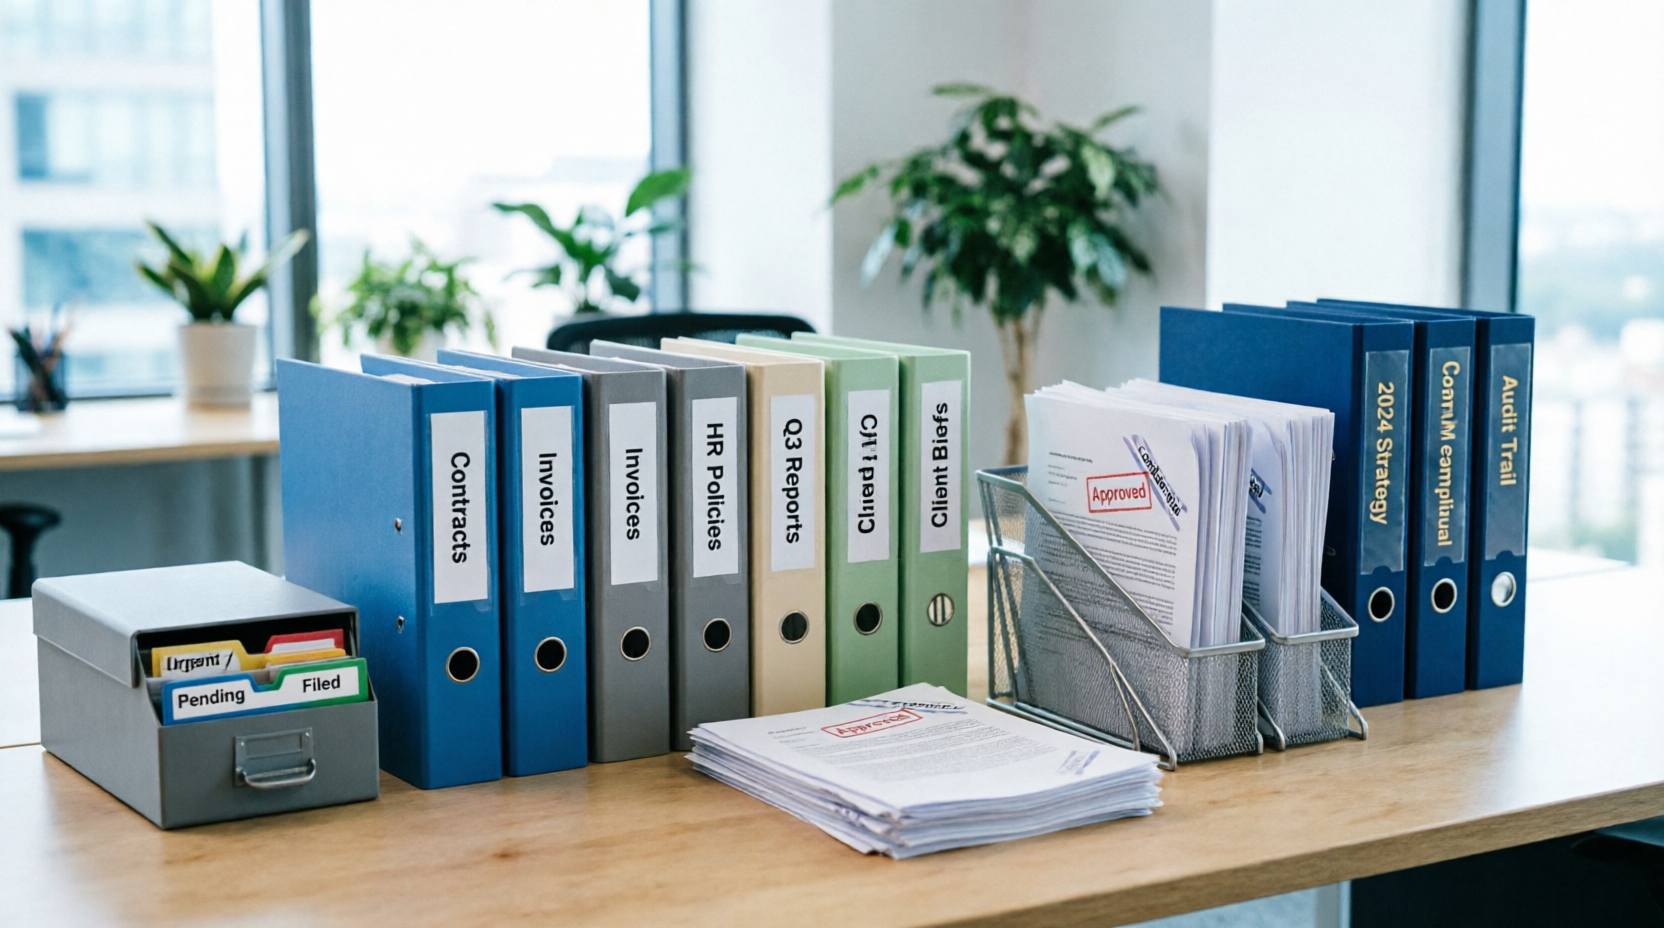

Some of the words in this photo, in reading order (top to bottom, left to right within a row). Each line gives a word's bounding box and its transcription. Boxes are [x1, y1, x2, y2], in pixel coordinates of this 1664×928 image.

[1376, 381, 1395, 434] 2024
[1501, 375, 1519, 433] Audit
[706, 422, 724, 456] HR
[783, 418, 803, 450] Q3
[1499, 437, 1518, 486] Trail
[450, 451, 471, 564] Contracts
[538, 452, 558, 546] Invoices
[625, 448, 645, 541] Invoices
[706, 466, 725, 551] Policies
[782, 457, 803, 544] Reports
[931, 466, 948, 528] Client
[1092, 482, 1147, 506] Approved
[1369, 438, 1393, 525] Strategy
[178, 688, 245, 709] Pending
[302, 674, 341, 693] Filed
